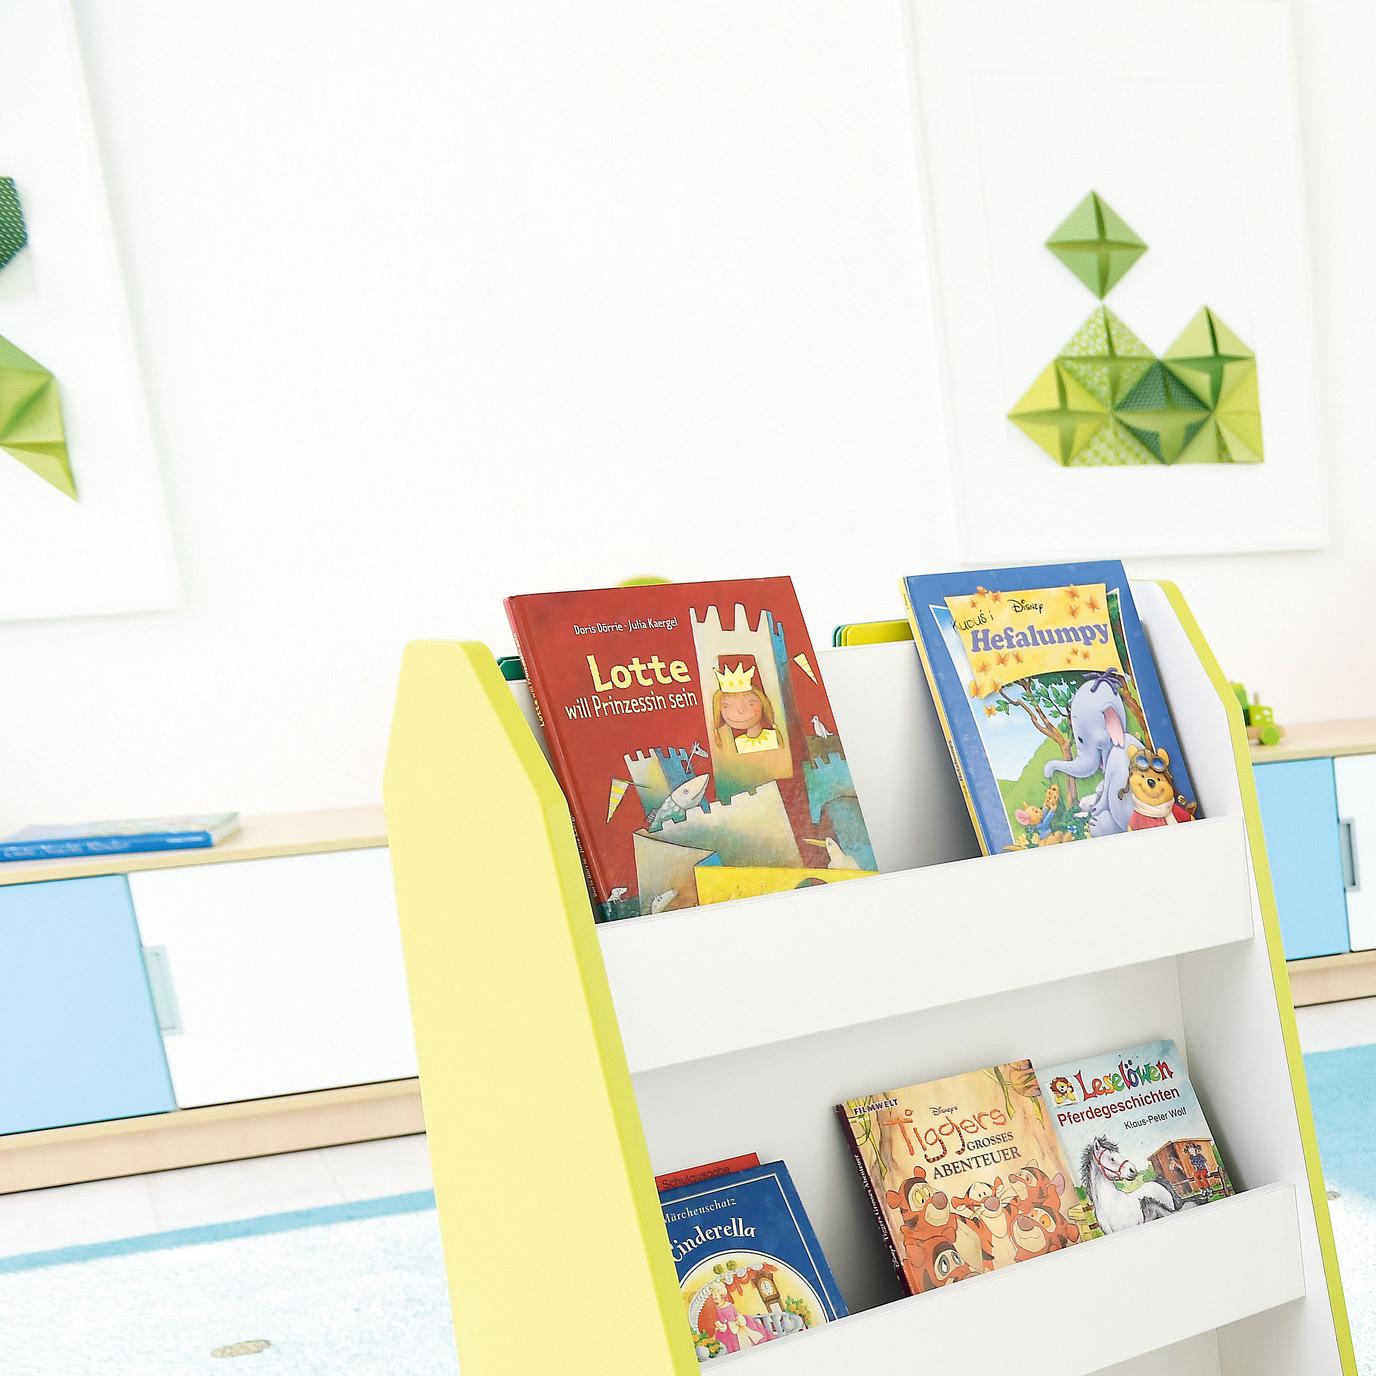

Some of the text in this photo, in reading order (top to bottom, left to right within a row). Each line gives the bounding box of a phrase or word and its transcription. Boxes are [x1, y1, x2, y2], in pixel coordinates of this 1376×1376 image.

[573, 616, 678, 635] Doris Dörrie Julia Kaergel
[970, 622, 1109, 653] Hefalumpy
[586, 654, 692, 693] Lotte
[565, 687, 698, 720] will Prinzessin sein
[1073, 1059, 1174, 1102] Leselöwen
[853, 1098, 899, 1116] FILMWELT
[1056, 1087, 1181, 1127] Pferdegeschichten
[1124, 1112, 1169, 1130] Klaus-Peter
[883, 1108, 1007, 1164] Tiggers
[967, 1131, 1014, 1151] GROSSES
[933, 1146, 1022, 1180] ABENTEUER
